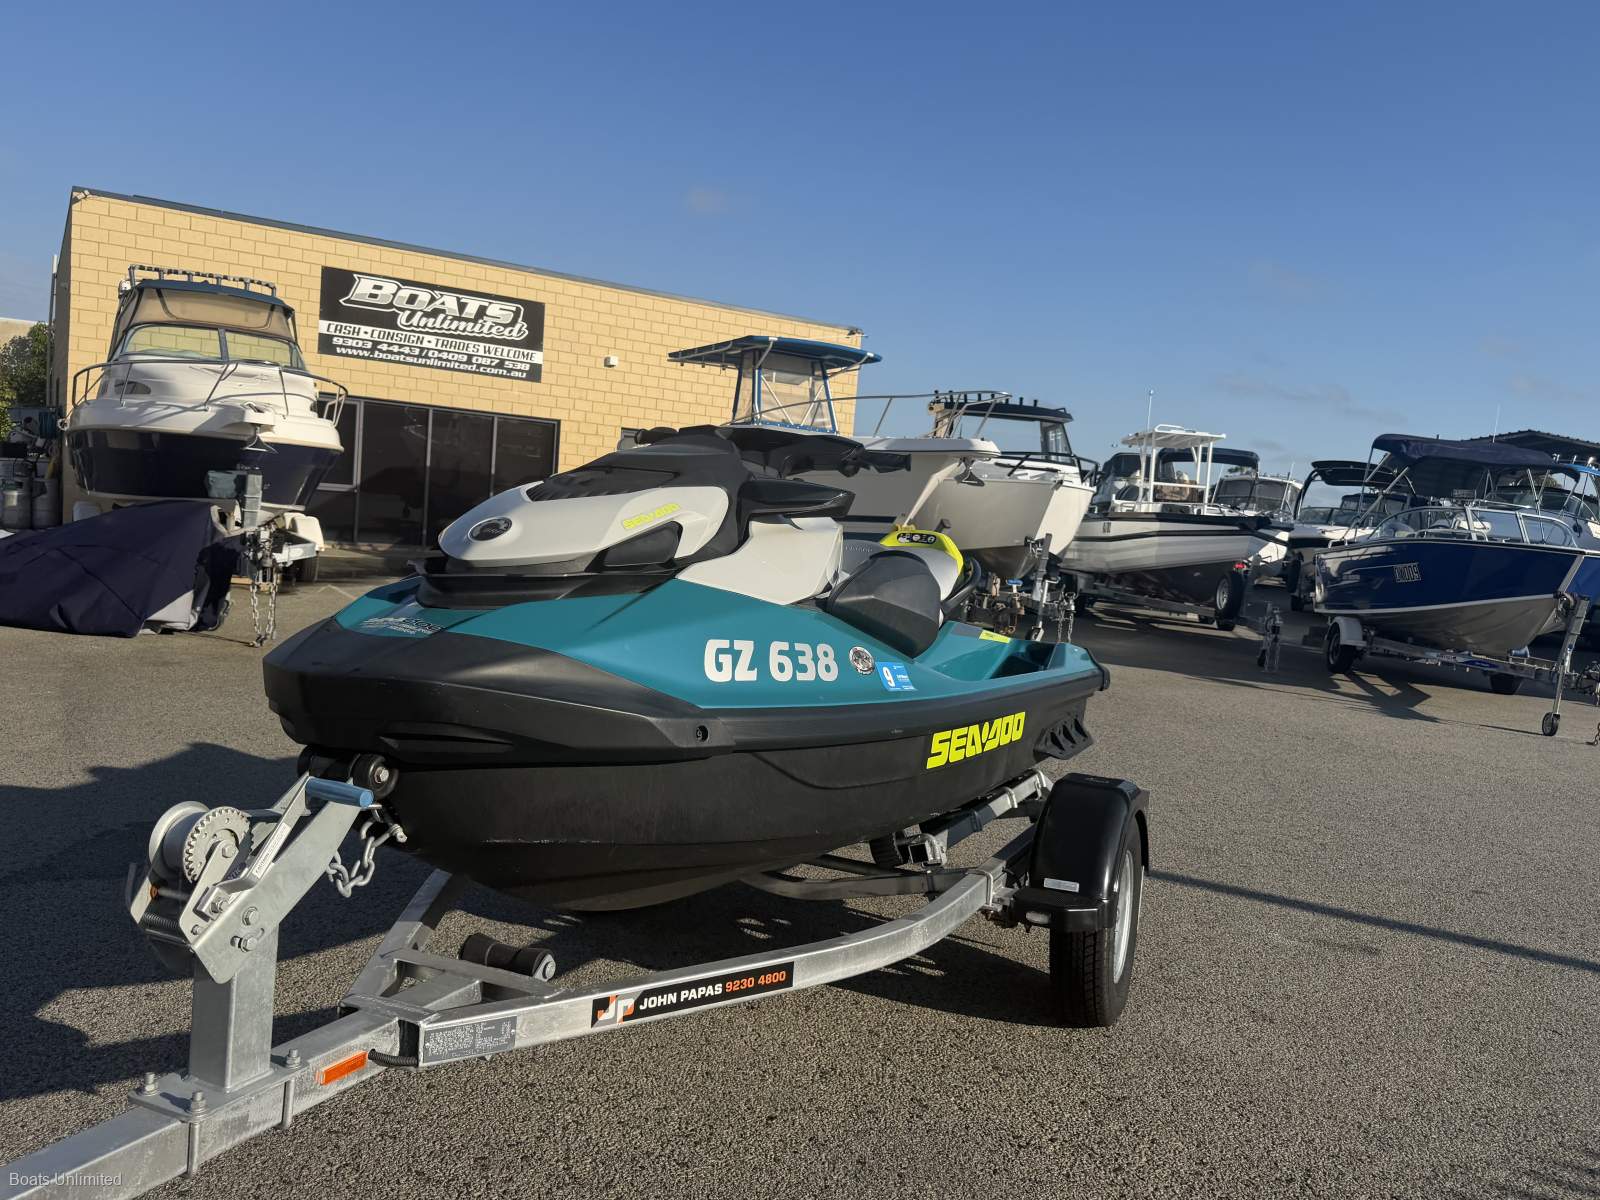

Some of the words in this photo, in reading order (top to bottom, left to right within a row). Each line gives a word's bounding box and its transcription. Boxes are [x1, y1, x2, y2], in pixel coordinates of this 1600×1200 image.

[346, 275, 521, 325] BOATS
[326, 322, 361, 337] CASH
[370, 328, 424, 346] CONSIGN
[434, 338, 481, 354] TRADES
[483, 345, 536, 362] WELCOME
[398, 309, 527, 340] Unlimited
[332, 336, 373, 350] 9303
[471, 356, 500, 367] 087
[503, 360, 530, 371] 538
[335, 346, 527, 378] www.boatsunlimited.com.au
[704, 639, 758, 683] GZ
[769, 640, 839, 683] 638
[639, 990, 678, 1011] JOHN
[680, 983, 723, 1003] PAPAS
[725, 976, 756, 993] 9230
[757, 970, 787, 986] 4800
